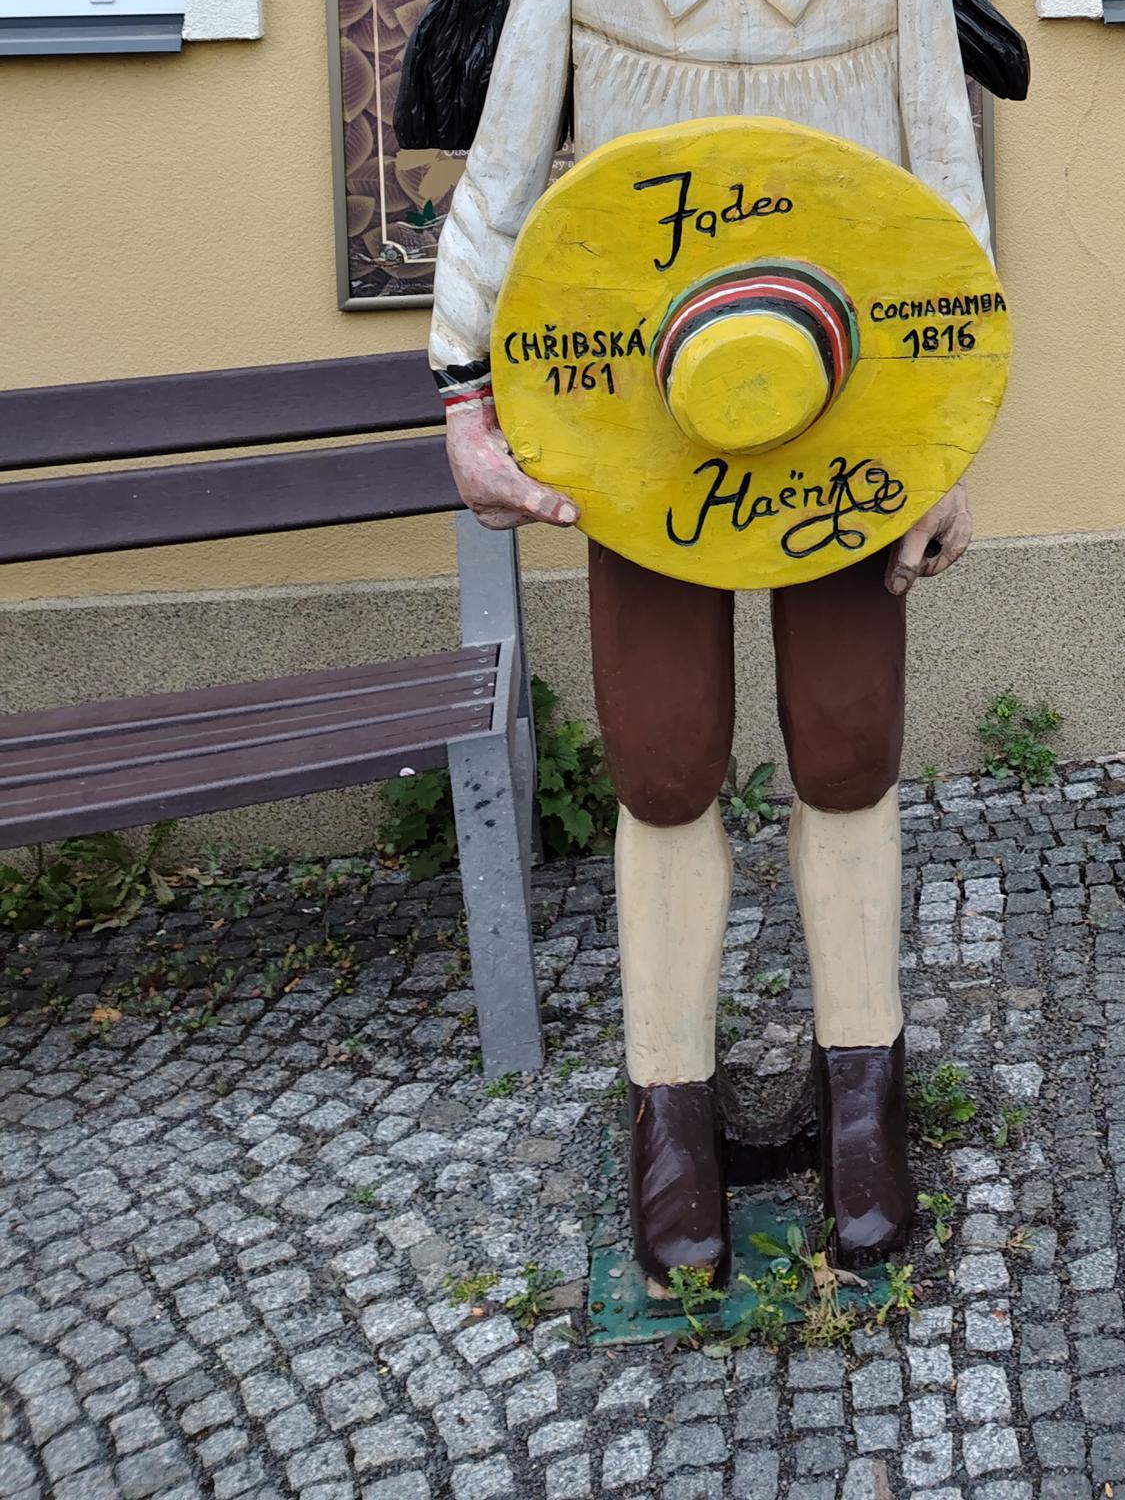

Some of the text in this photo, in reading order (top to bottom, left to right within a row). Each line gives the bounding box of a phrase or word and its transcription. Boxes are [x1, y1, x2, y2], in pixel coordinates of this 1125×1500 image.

[504, 318, 651, 364] CHŘIBSKÁ
[902, 321, 976, 359] 1816
[545, 361, 615, 396] 1761
